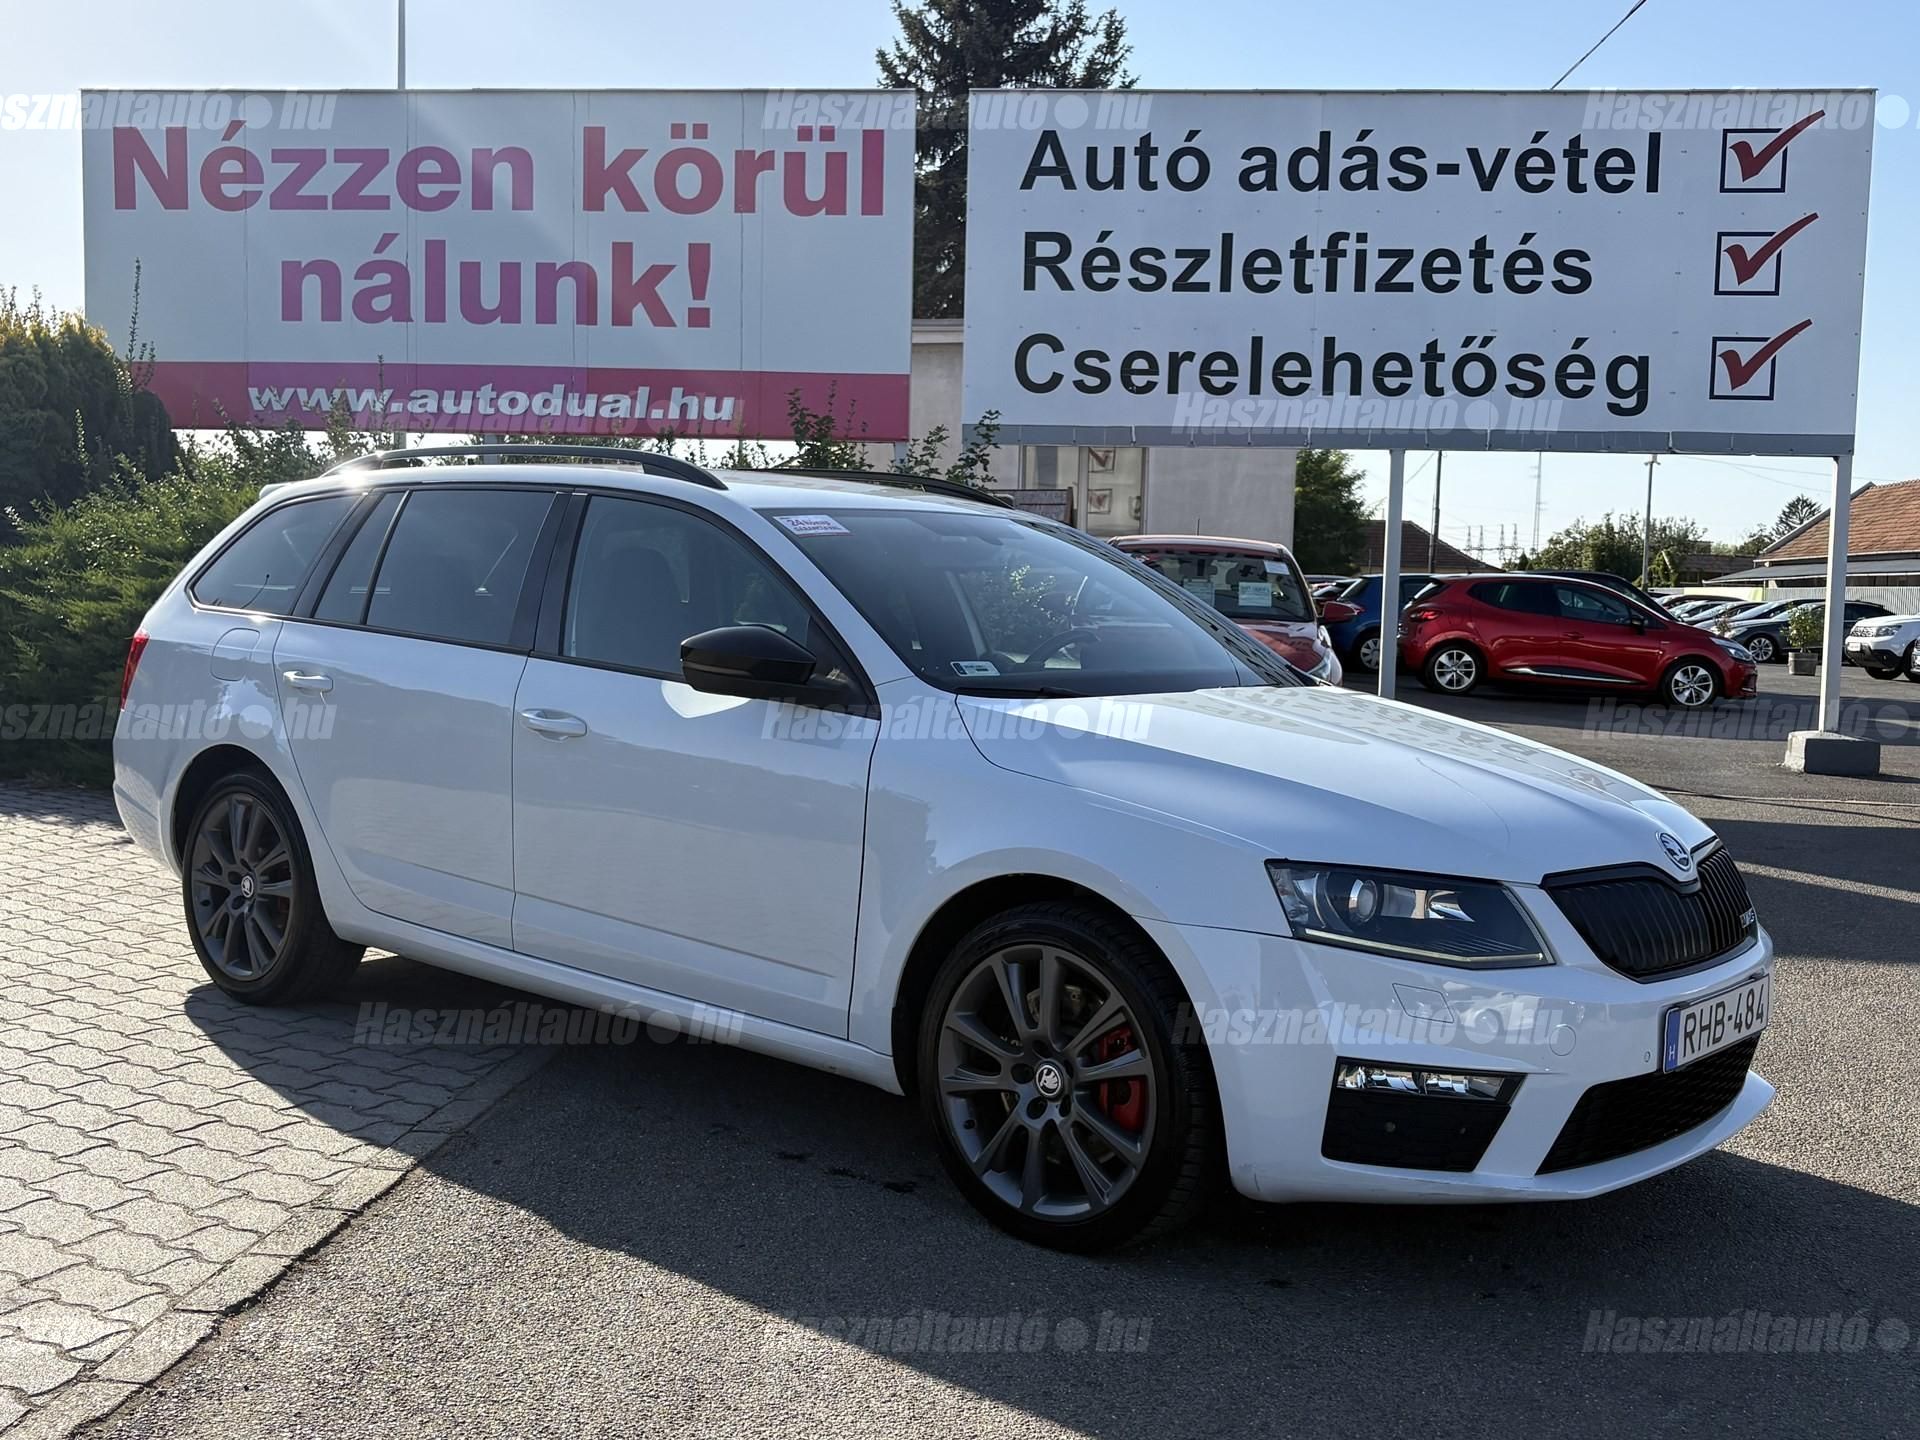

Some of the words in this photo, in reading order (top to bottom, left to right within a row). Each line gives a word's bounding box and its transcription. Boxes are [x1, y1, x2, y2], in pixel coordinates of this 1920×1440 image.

[112, 119, 534, 211] Nézzen
[583, 122, 885, 216] körül
[1019, 129, 1212, 193] Autó
[1237, 129, 1662, 194] adás-vétel
[281, 233, 712, 328] nálunk!
[1022, 230, 1593, 295] Részletfizetés
[247, 382, 735, 421] www.autodual.hu
[1014, 333, 1651, 417] Cserelehetőség
[1668, 1044, 1677, 1062] H
[1682, 983, 1765, 1058] RHB-484
